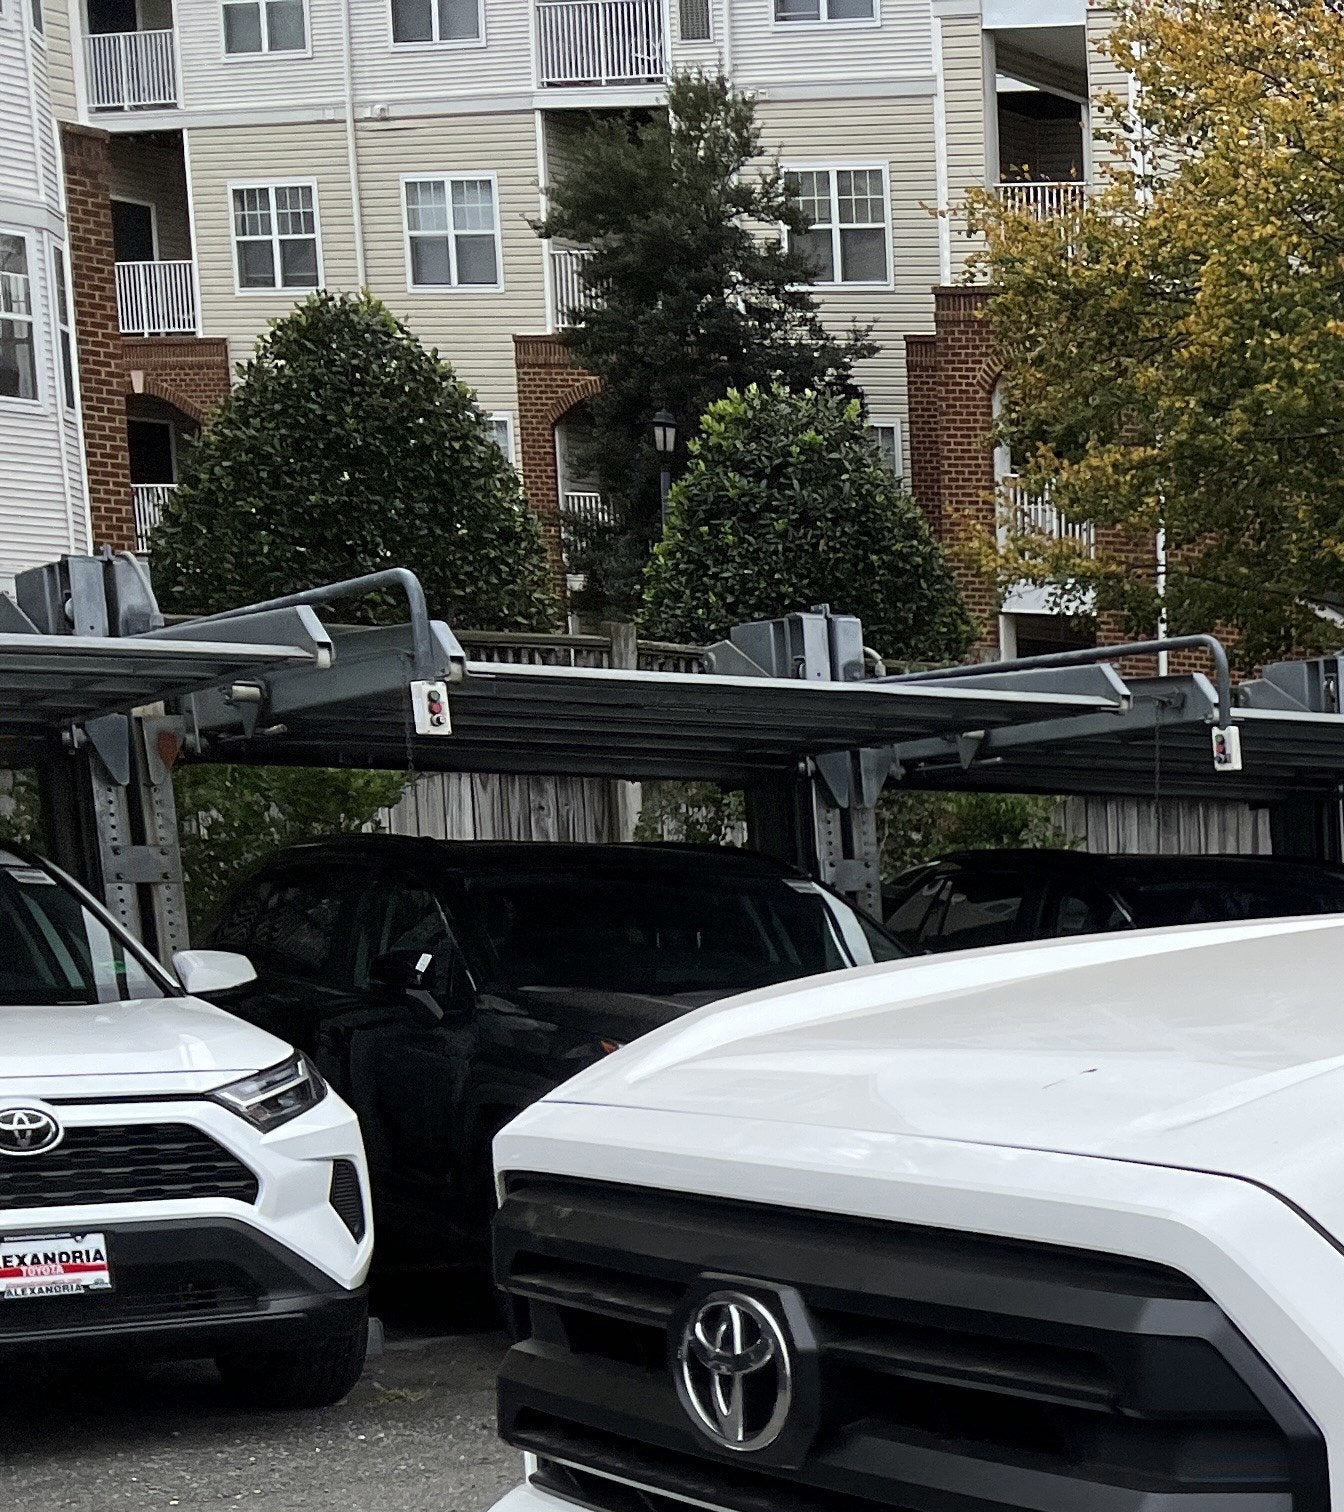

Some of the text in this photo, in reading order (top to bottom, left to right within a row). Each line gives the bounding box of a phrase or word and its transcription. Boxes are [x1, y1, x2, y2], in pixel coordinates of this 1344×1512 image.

[0, 1248, 105, 1269] EXANDRIA
[21, 1263, 64, 1276] TOYOTA
[5, 1285, 83, 1297] ALEXANDRIA
